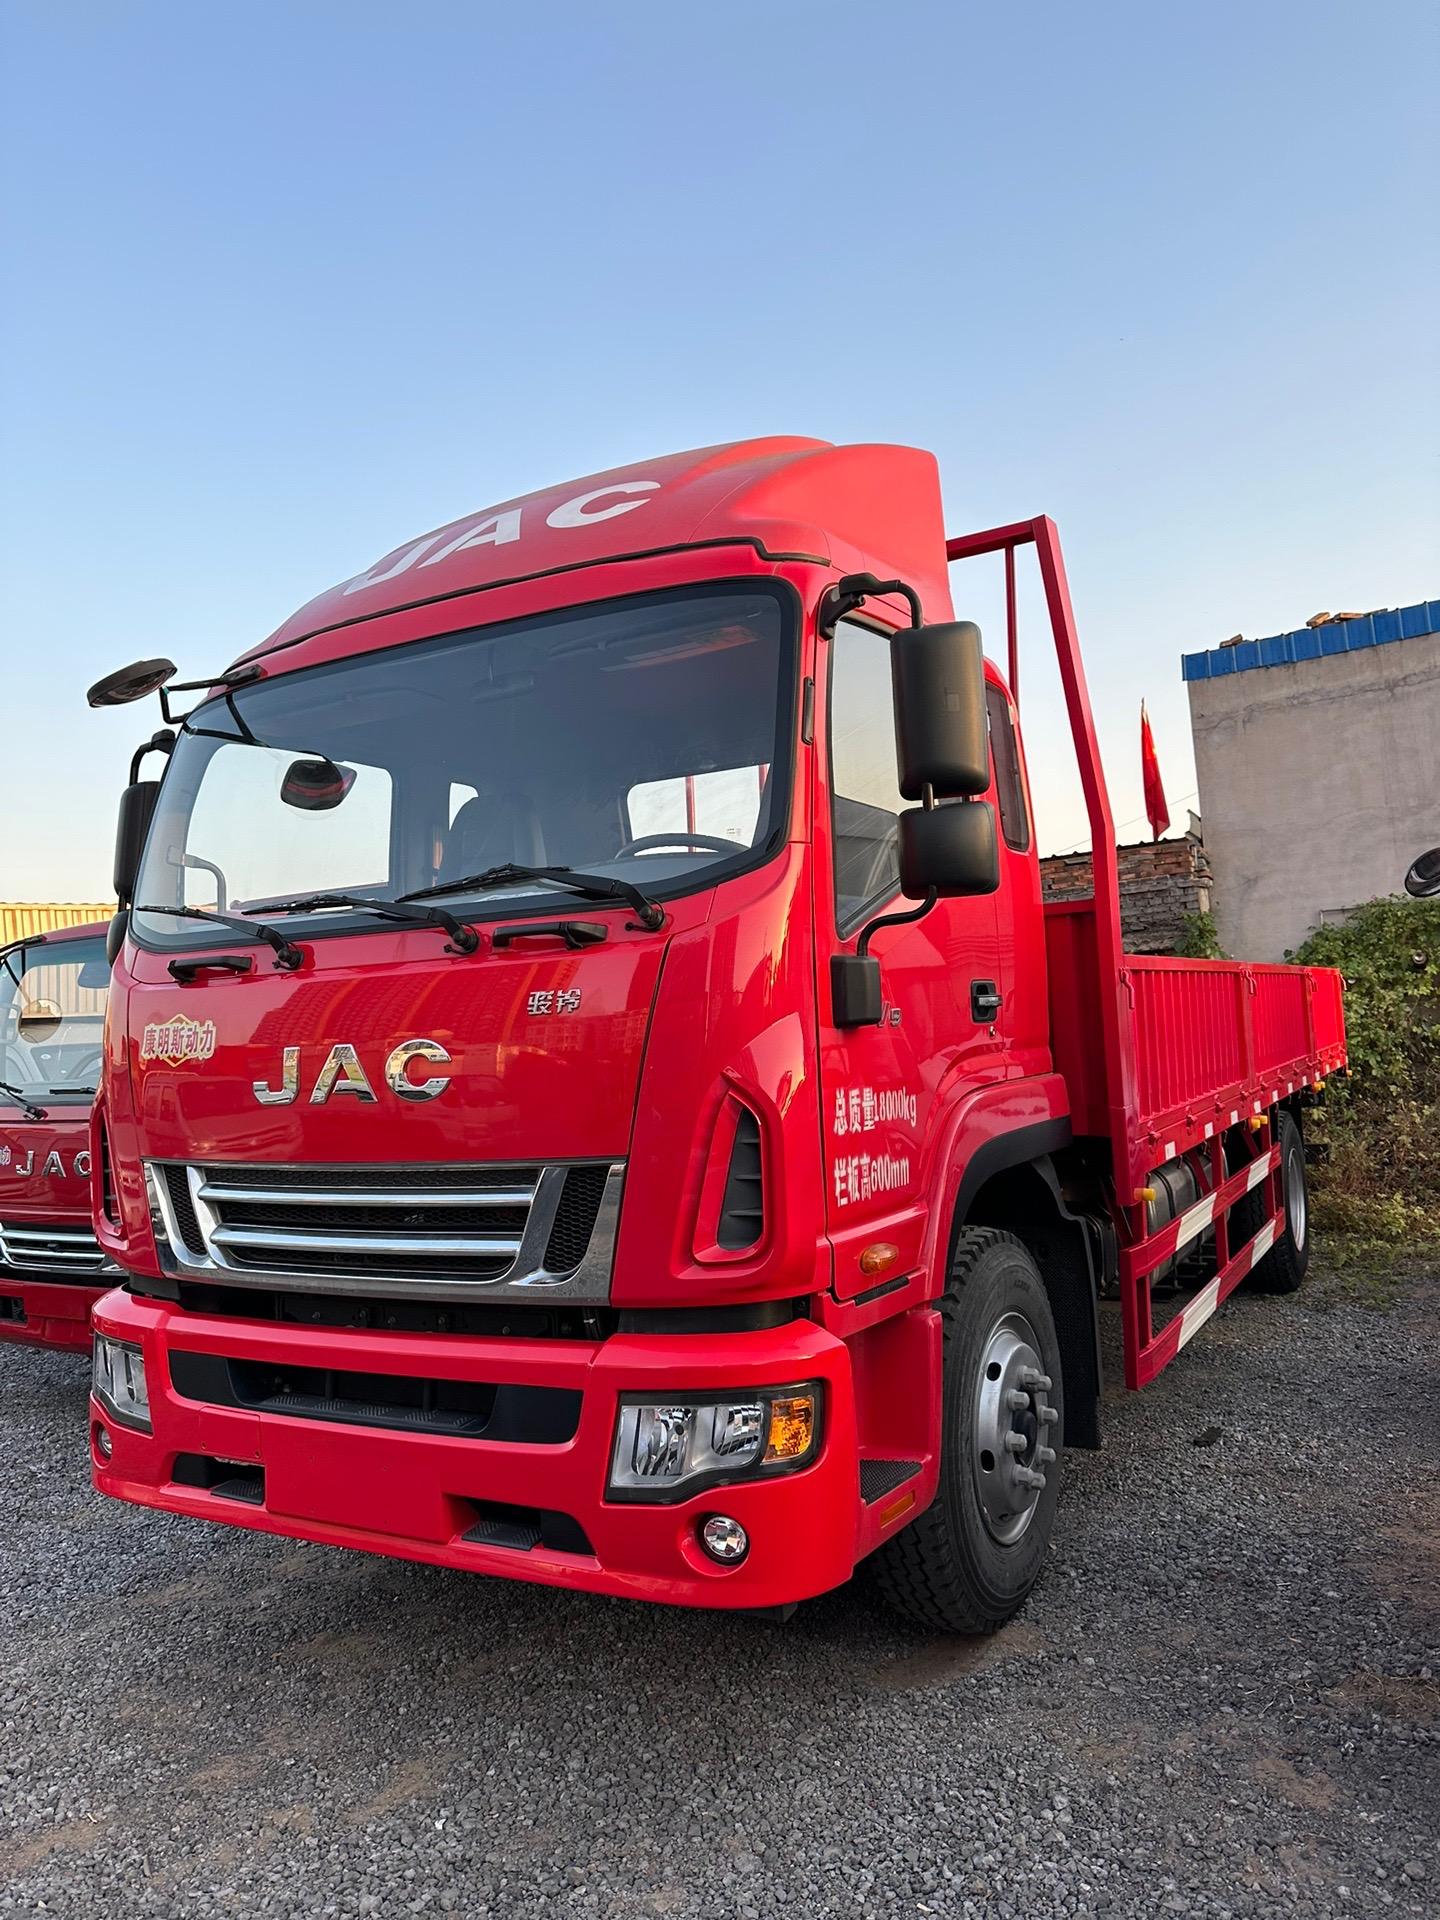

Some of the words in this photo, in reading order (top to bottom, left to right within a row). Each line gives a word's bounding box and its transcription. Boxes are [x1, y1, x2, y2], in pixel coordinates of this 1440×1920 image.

[343, 481, 661, 596] JAC
[527, 988, 581, 1015] 骏铃
[142, 1020, 216, 1059] 康明斯动力
[252, 1038, 452, 1106] JAC
[833, 1086, 917, 1136] 总质量18000kg
[15, 1150, 91, 1178] JAC
[834, 1153, 910, 1208] 栏板高600mm
